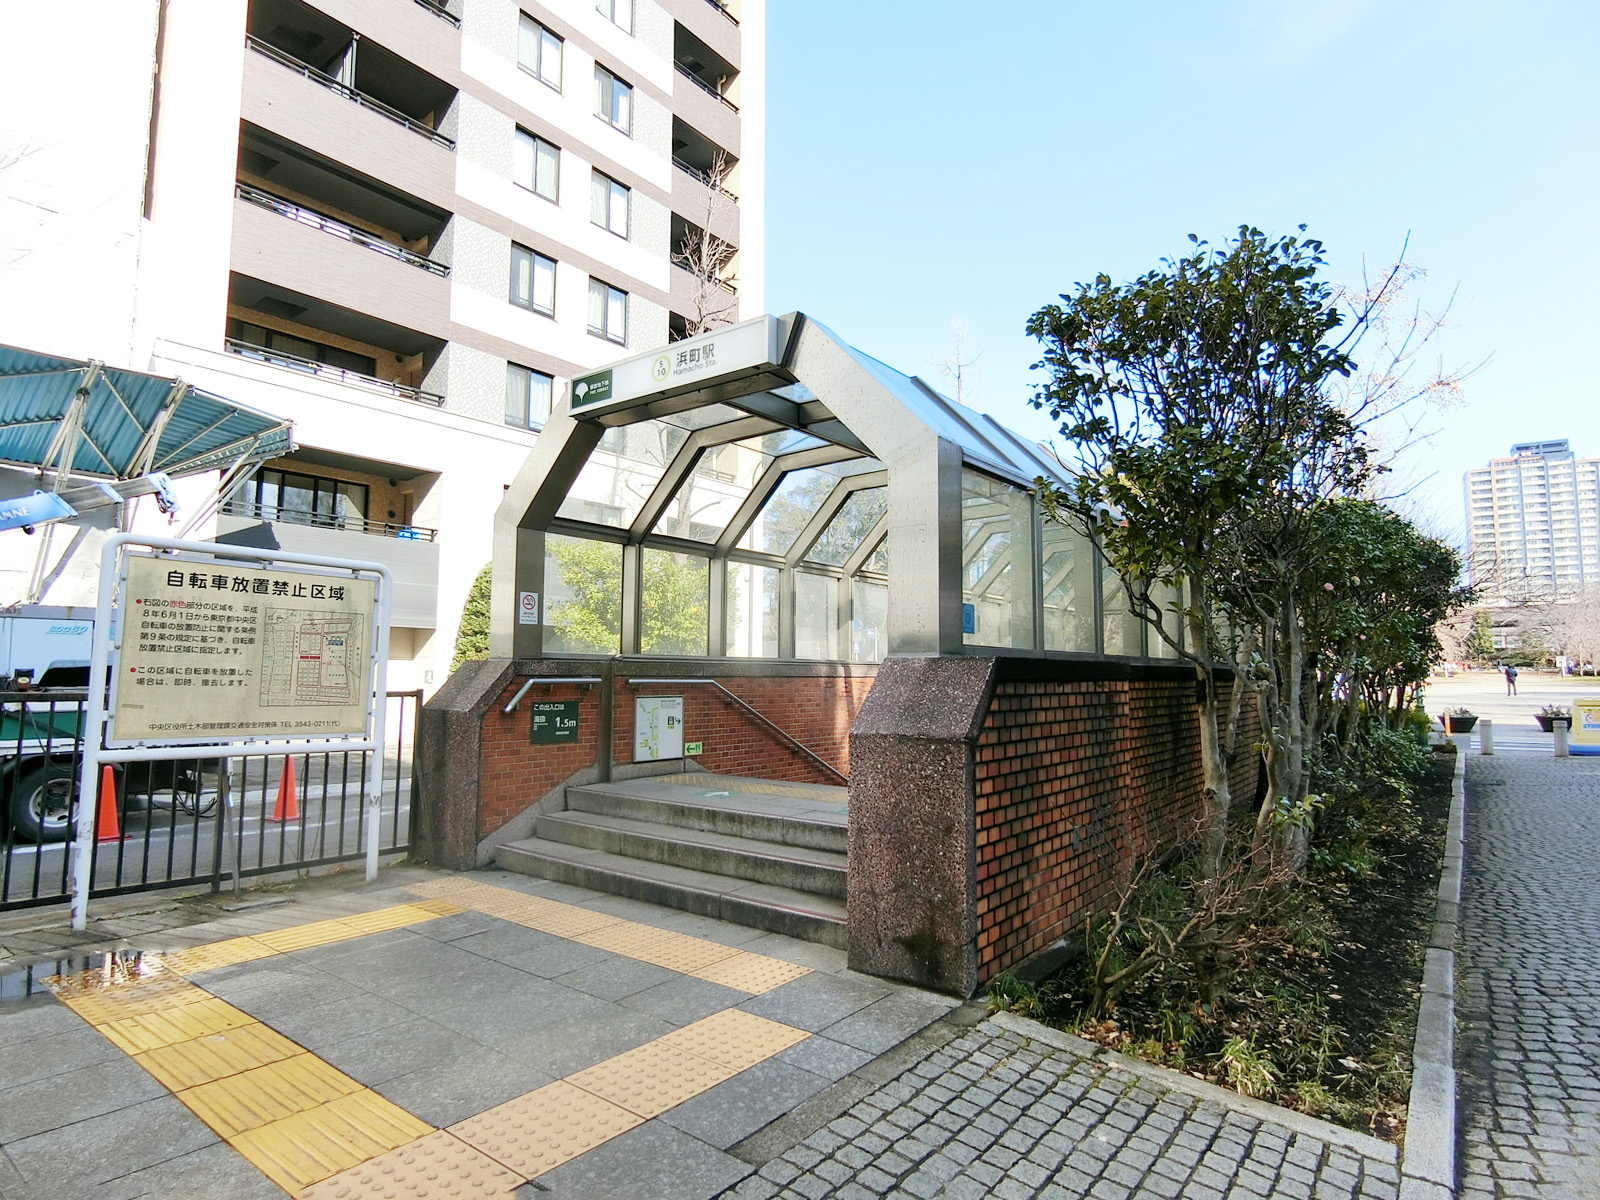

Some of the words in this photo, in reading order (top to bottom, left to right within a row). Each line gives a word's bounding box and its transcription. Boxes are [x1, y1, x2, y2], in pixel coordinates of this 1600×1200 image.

[676, 343, 715, 367] 浜町駅
[657, 368, 666, 377] 10
[673, 363, 703, 377] Hamacho
[705, 360, 718, 368] Sta.
[167, 570, 345, 601] 自転車放置禁止区域
[143, 598, 258, 614] 右図の赤色部分の区域を、平成
[138, 666, 253, 676] この区域に自転車を放置した
[555, 716, 577, 728] 1.5m
